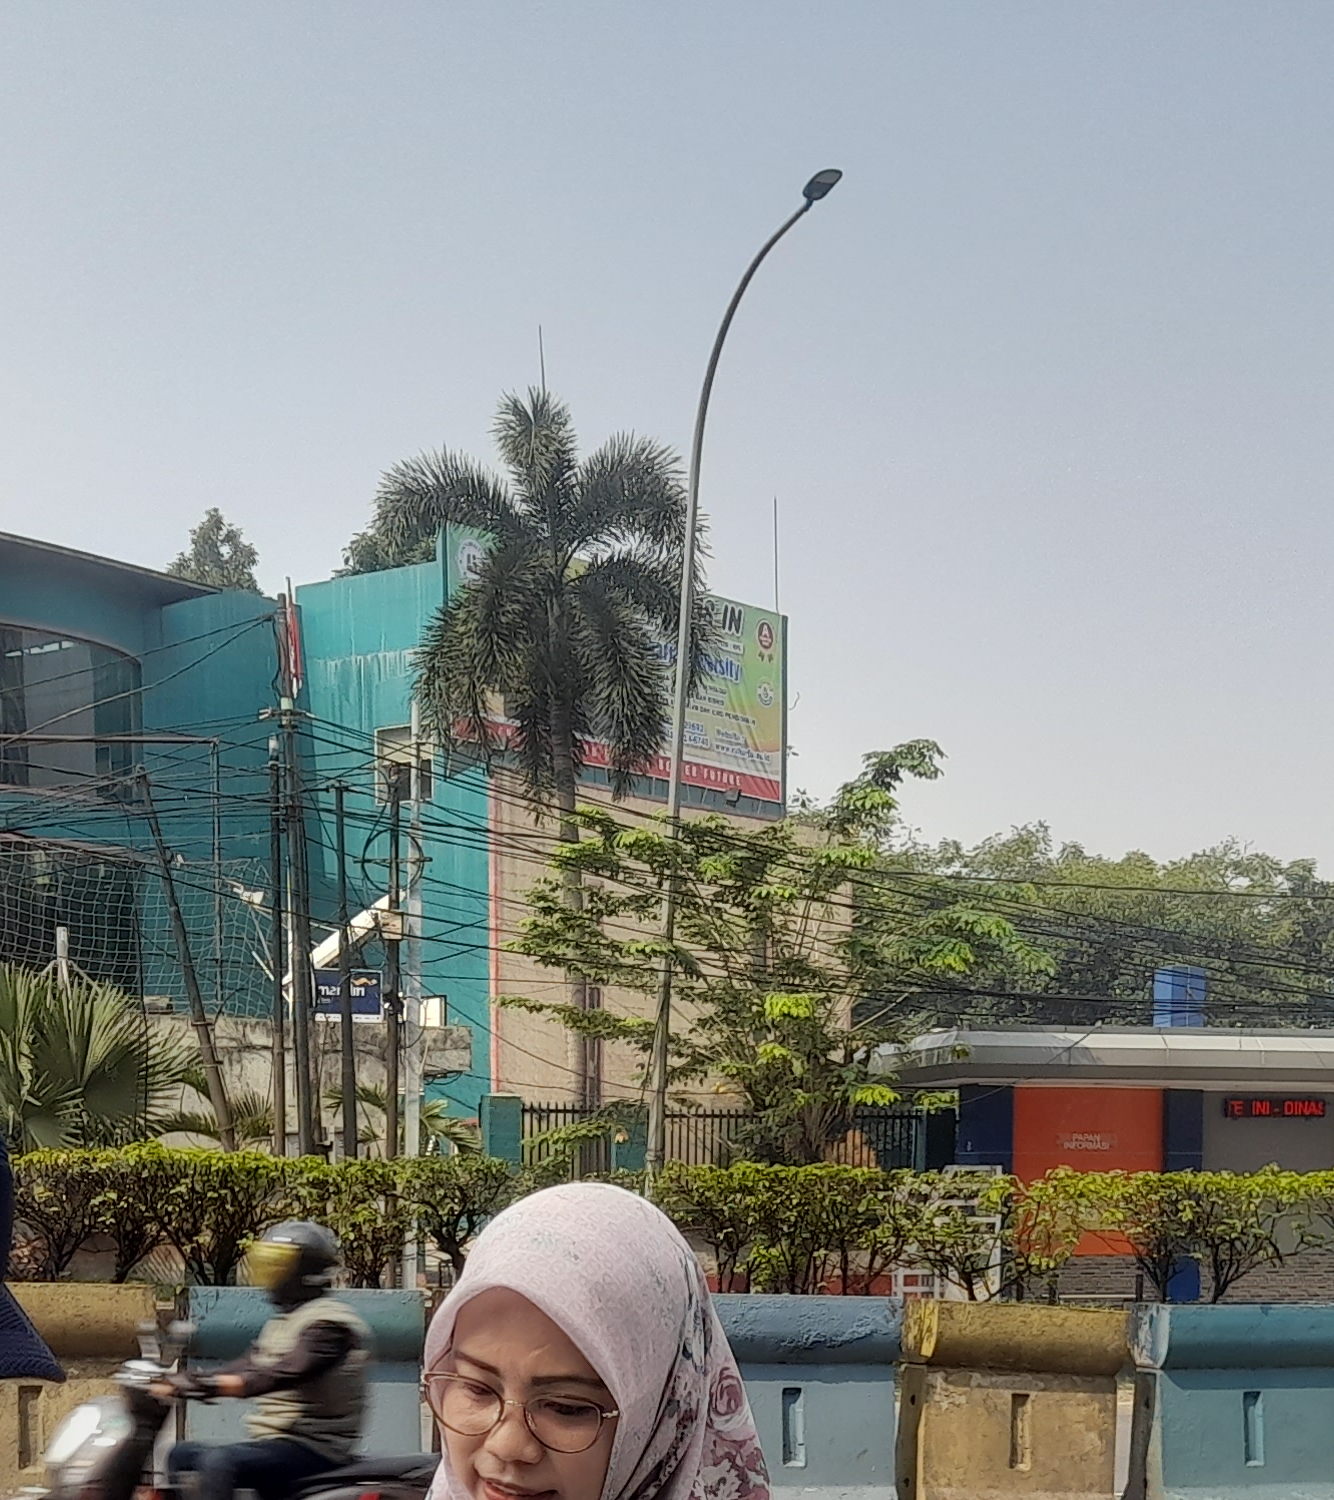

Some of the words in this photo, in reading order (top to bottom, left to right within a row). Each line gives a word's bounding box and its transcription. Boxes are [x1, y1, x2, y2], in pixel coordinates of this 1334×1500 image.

[658, 757, 697, 778] BEER
[1252, 1101, 1270, 1115] INI
[1283, 1101, 1324, 1116] DINAS
